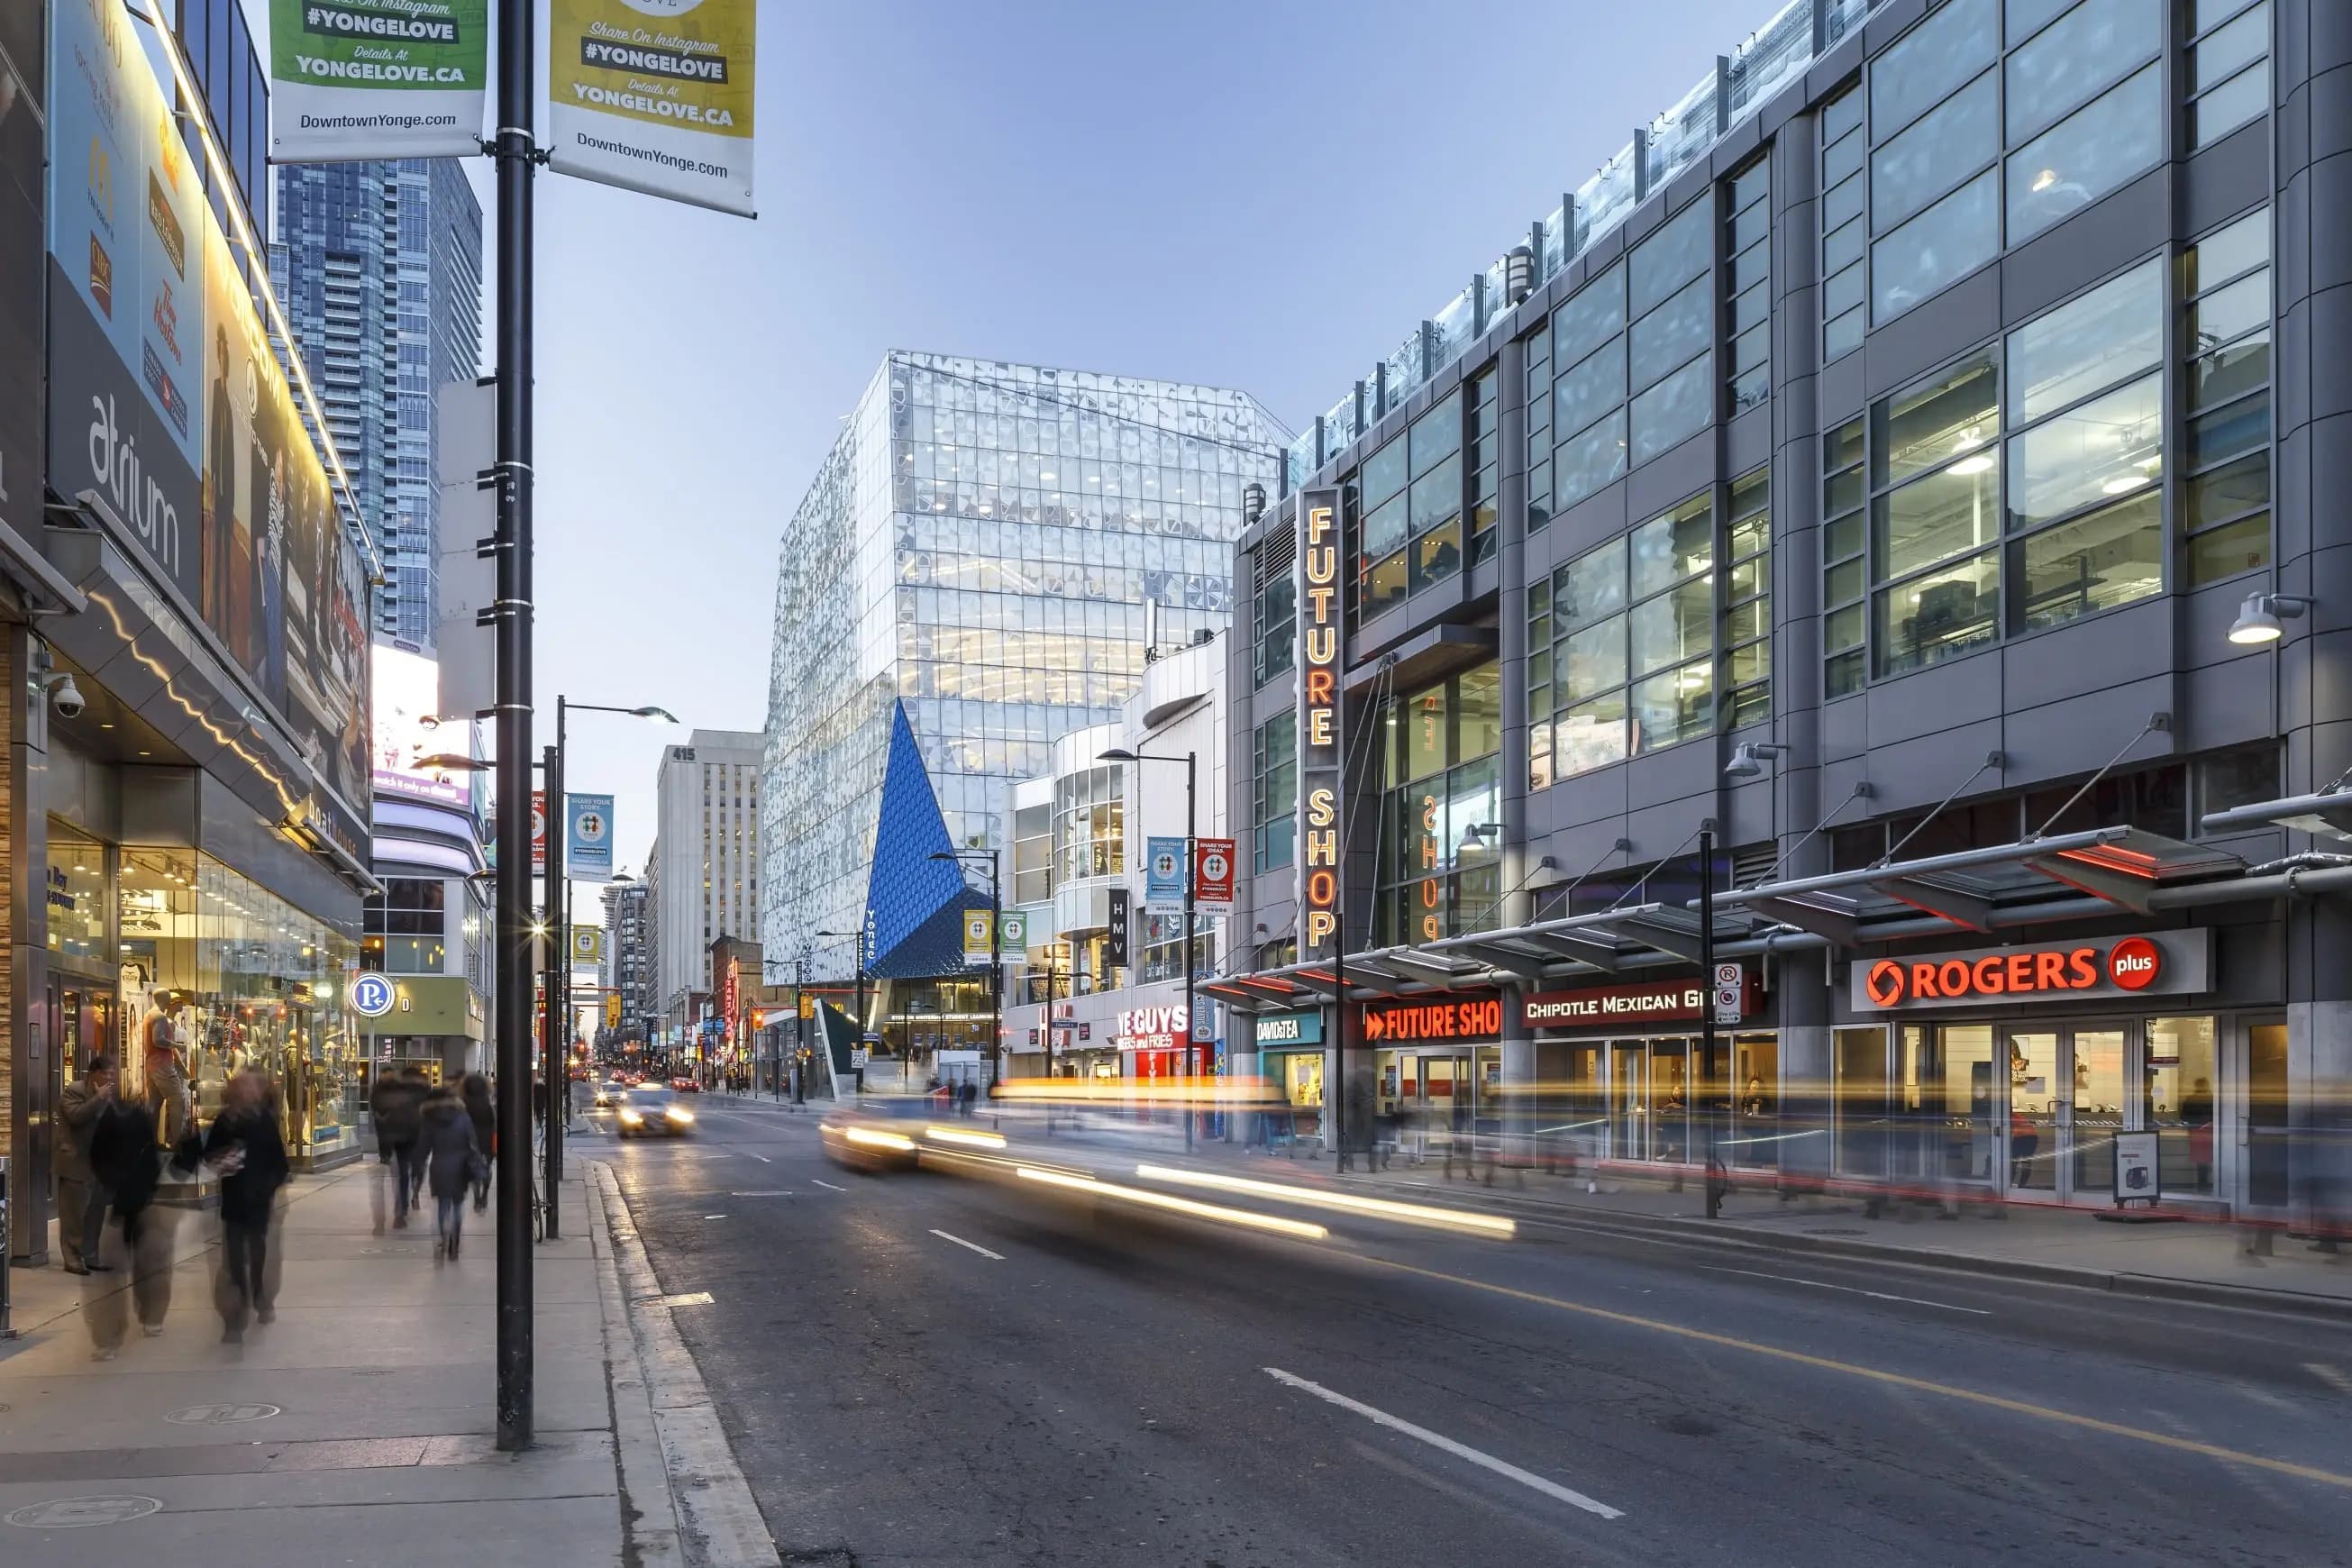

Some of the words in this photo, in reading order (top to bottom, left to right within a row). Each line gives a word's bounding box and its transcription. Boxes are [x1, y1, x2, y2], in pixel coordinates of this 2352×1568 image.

[306, 8, 454, 40] #YONGELOVE
[588, 22, 629, 41] Share
[632, 29, 652, 43] On
[653, 32, 719, 56] Instagram
[296, 55, 465, 82] YONGELOVE.CA
[353, 45, 392, 59] Details
[395, 50, 408, 60] At
[585, 42, 724, 78] #YONGELOVE
[627, 78, 664, 96] Details
[667, 86, 679, 96] At
[572, 83, 734, 126] YONGELOVE.CA
[300, 112, 456, 131] DowntownYonge.com
[577, 132, 728, 178] DowntownYonge.com
[89, 393, 179, 578] atrium
[1307, 506, 1336, 746] FUTURE
[672, 747, 696, 761] 415
[1308, 788, 1336, 946] SHOP
[867, 909, 876, 960] Yonge
[1112, 902, 1125, 954] HMV
[1910, 947, 2099, 998] ROGERS
[2115, 953, 2153, 977] plus
[361, 983, 380, 1007] P
[1527, 999, 1598, 1018] CHIPOTLE
[1602, 994, 1677, 1013] MEXICAN
[1133, 1005, 1189, 1035] GUYS
[1256, 1019, 1299, 1041] DAVIDsTEA
[1385, 1004, 1455, 1040] FUTURE
[1458, 999, 1502, 1036] SHO
[1135, 1038, 1149, 1049] and
[1149, 1034, 1173, 1048] FRIES
